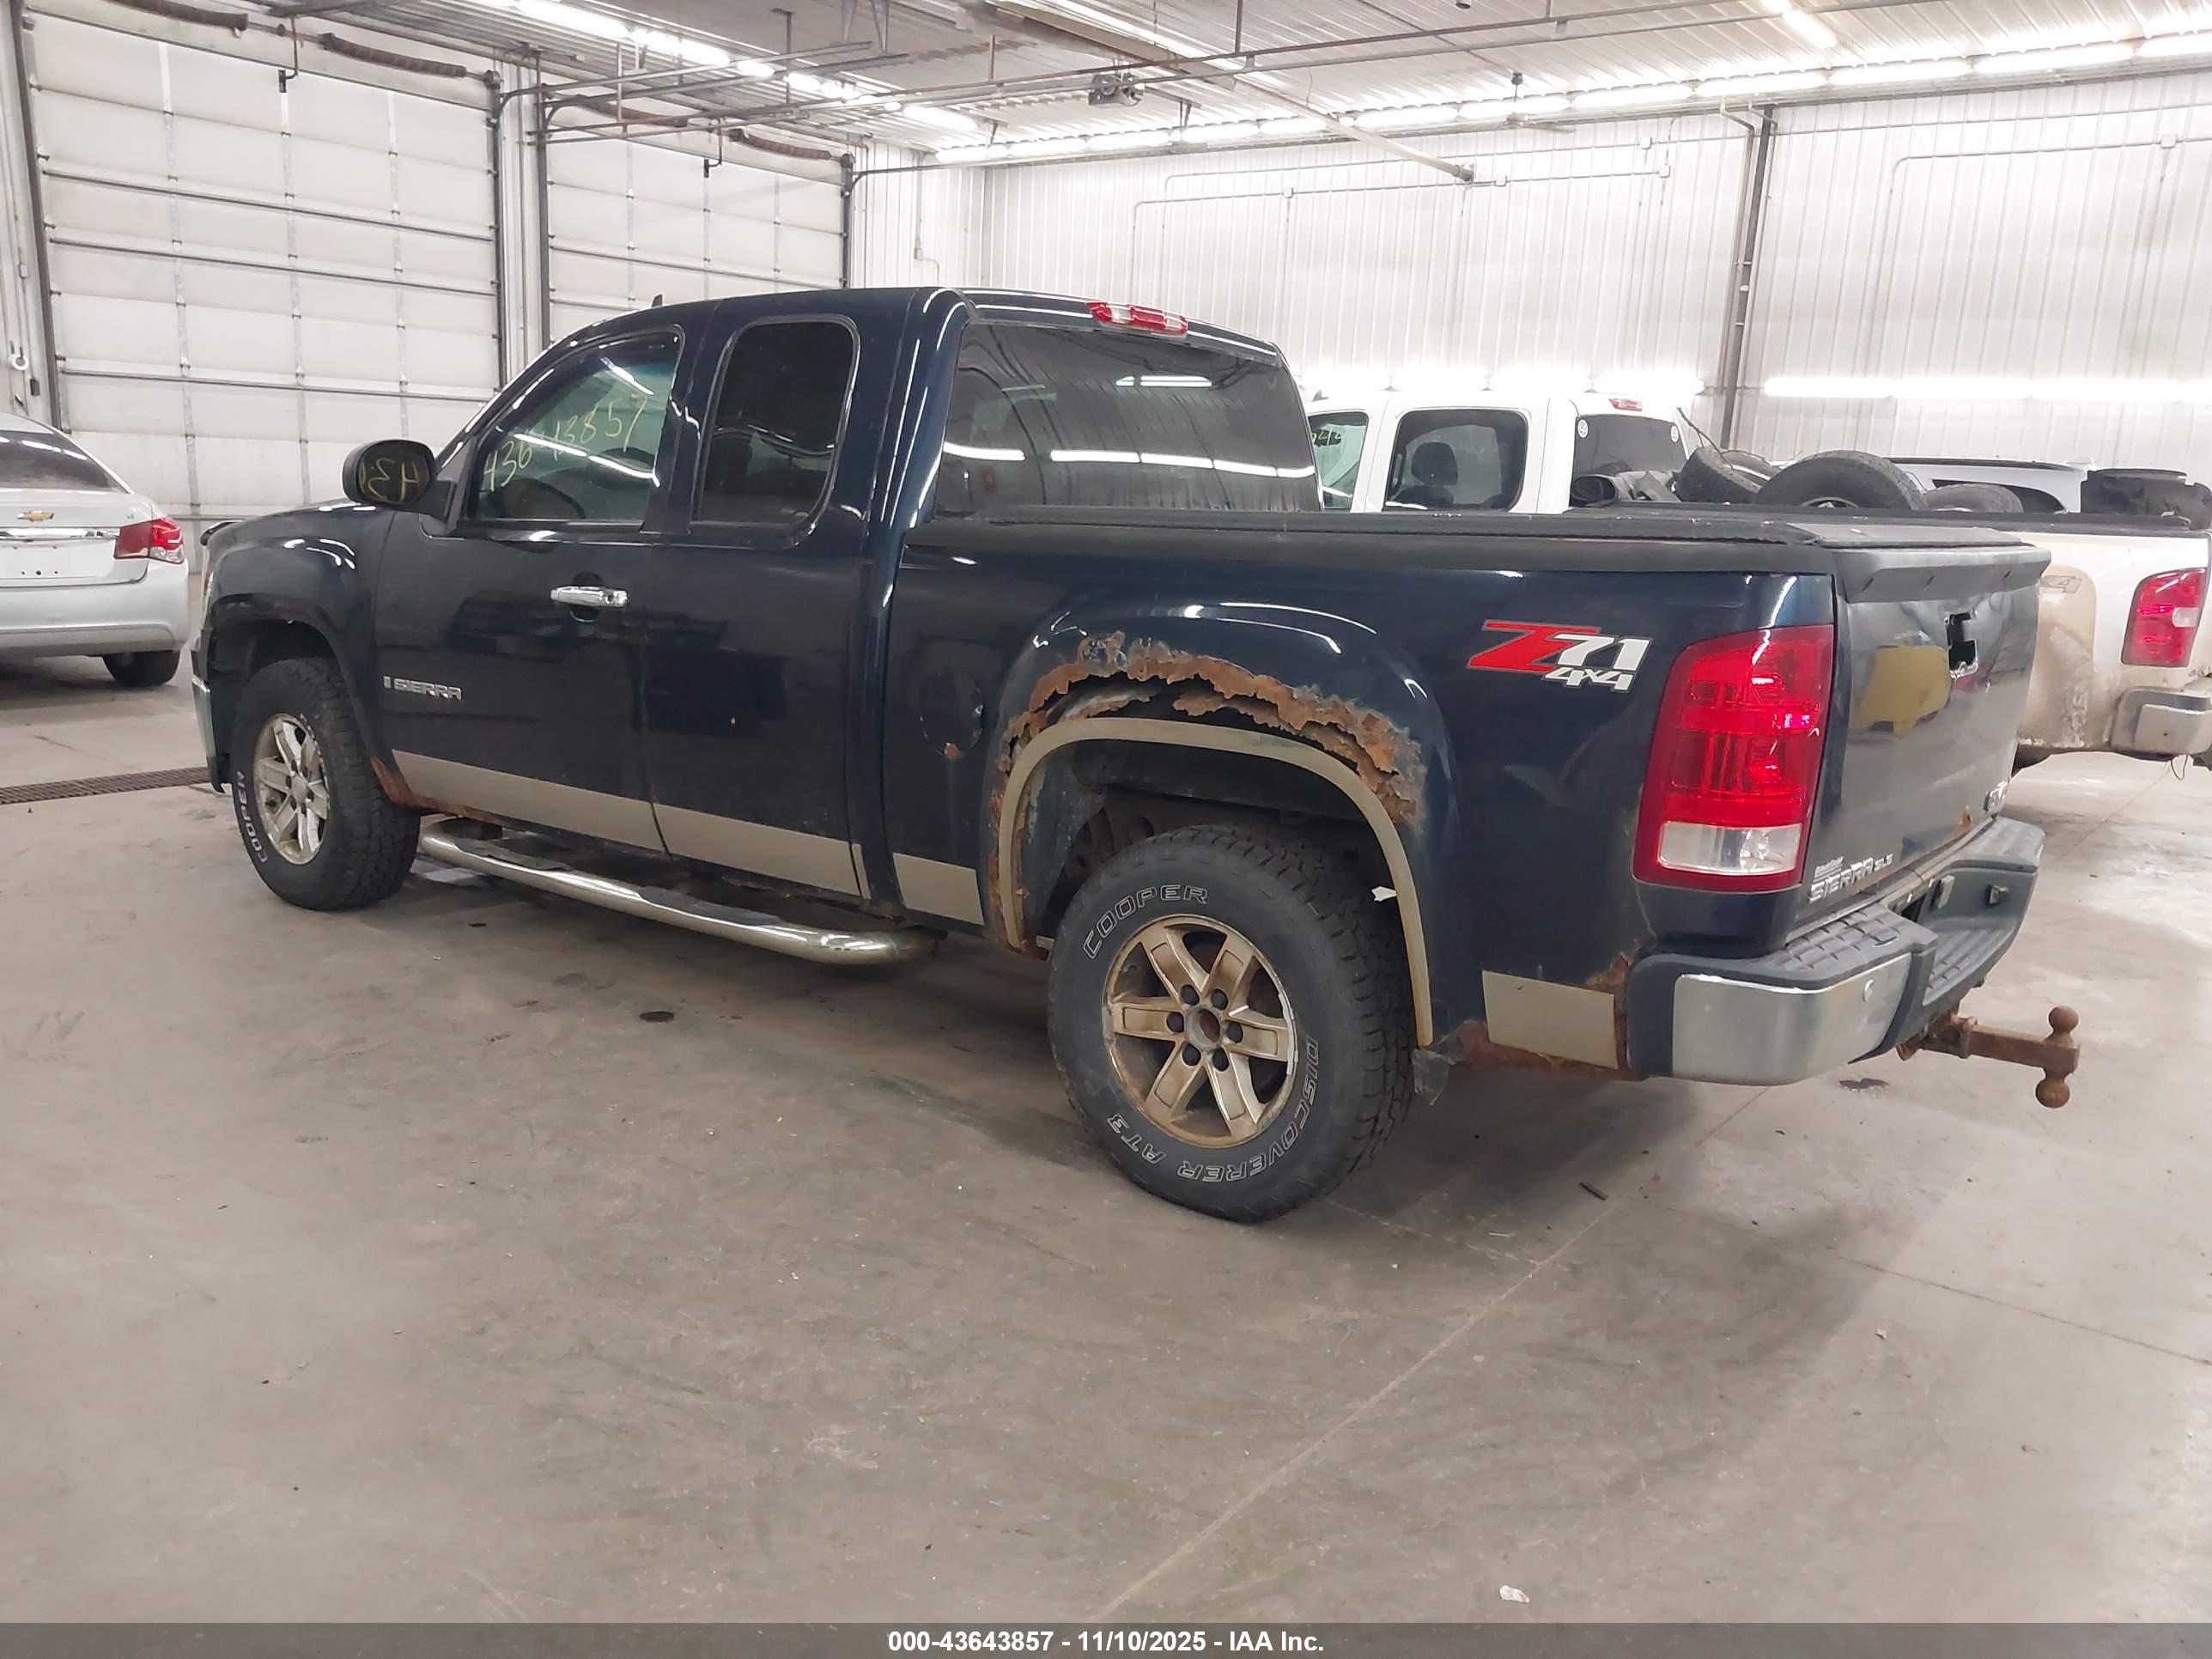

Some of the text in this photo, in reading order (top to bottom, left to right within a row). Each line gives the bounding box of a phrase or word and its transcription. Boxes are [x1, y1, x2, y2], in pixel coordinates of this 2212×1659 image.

[1459, 619, 1652, 672] Z71
[393, 678, 462, 701] SIERRA
[1809, 857, 1873, 902] SIERRA
[1083, 884, 1207, 959] COOPER
[1107, 1035, 1319, 1182] DISCOVERER AT3
